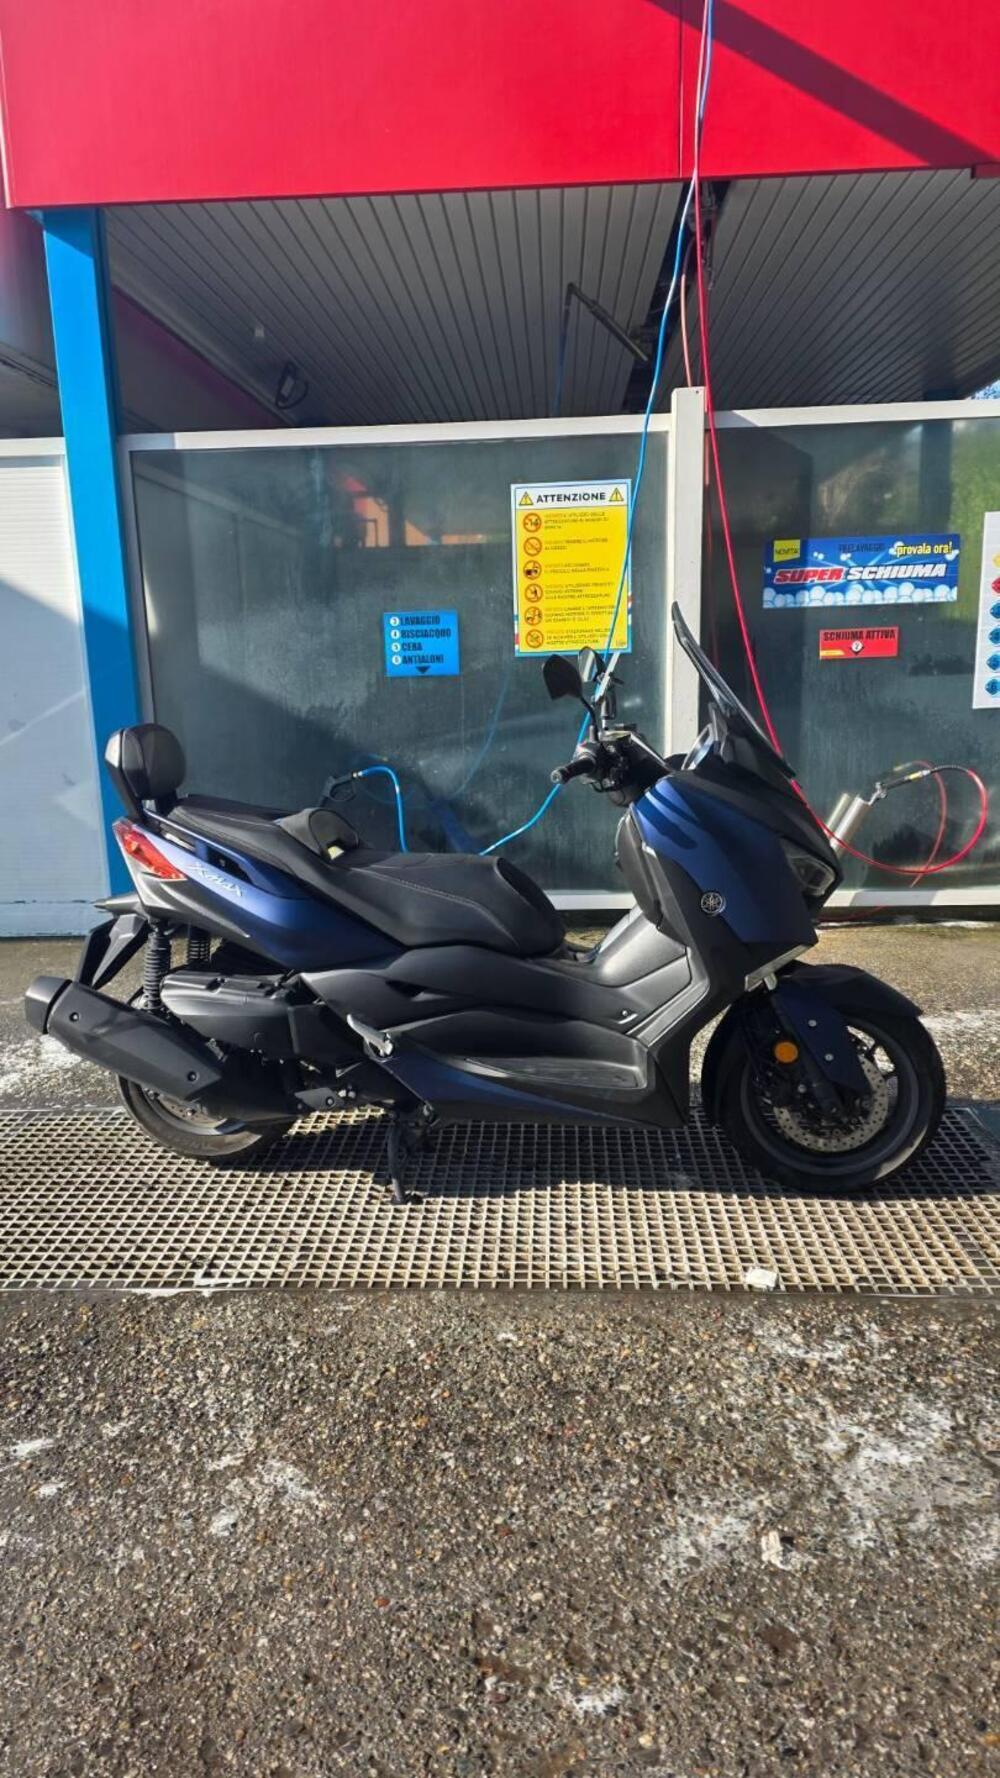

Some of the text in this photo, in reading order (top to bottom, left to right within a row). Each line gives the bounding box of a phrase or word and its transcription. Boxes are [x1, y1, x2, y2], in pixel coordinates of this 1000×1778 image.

[536, 492, 606, 503] ATTENZIONE
[896, 541, 953, 557] provala ora!
[774, 563, 947, 584] SUPER SCHIUMA
[400, 615, 441, 626] LAVAGGIO
[823, 629, 896, 641] SCHIUMA ATTIVA
[402, 642, 423, 651] CERA
